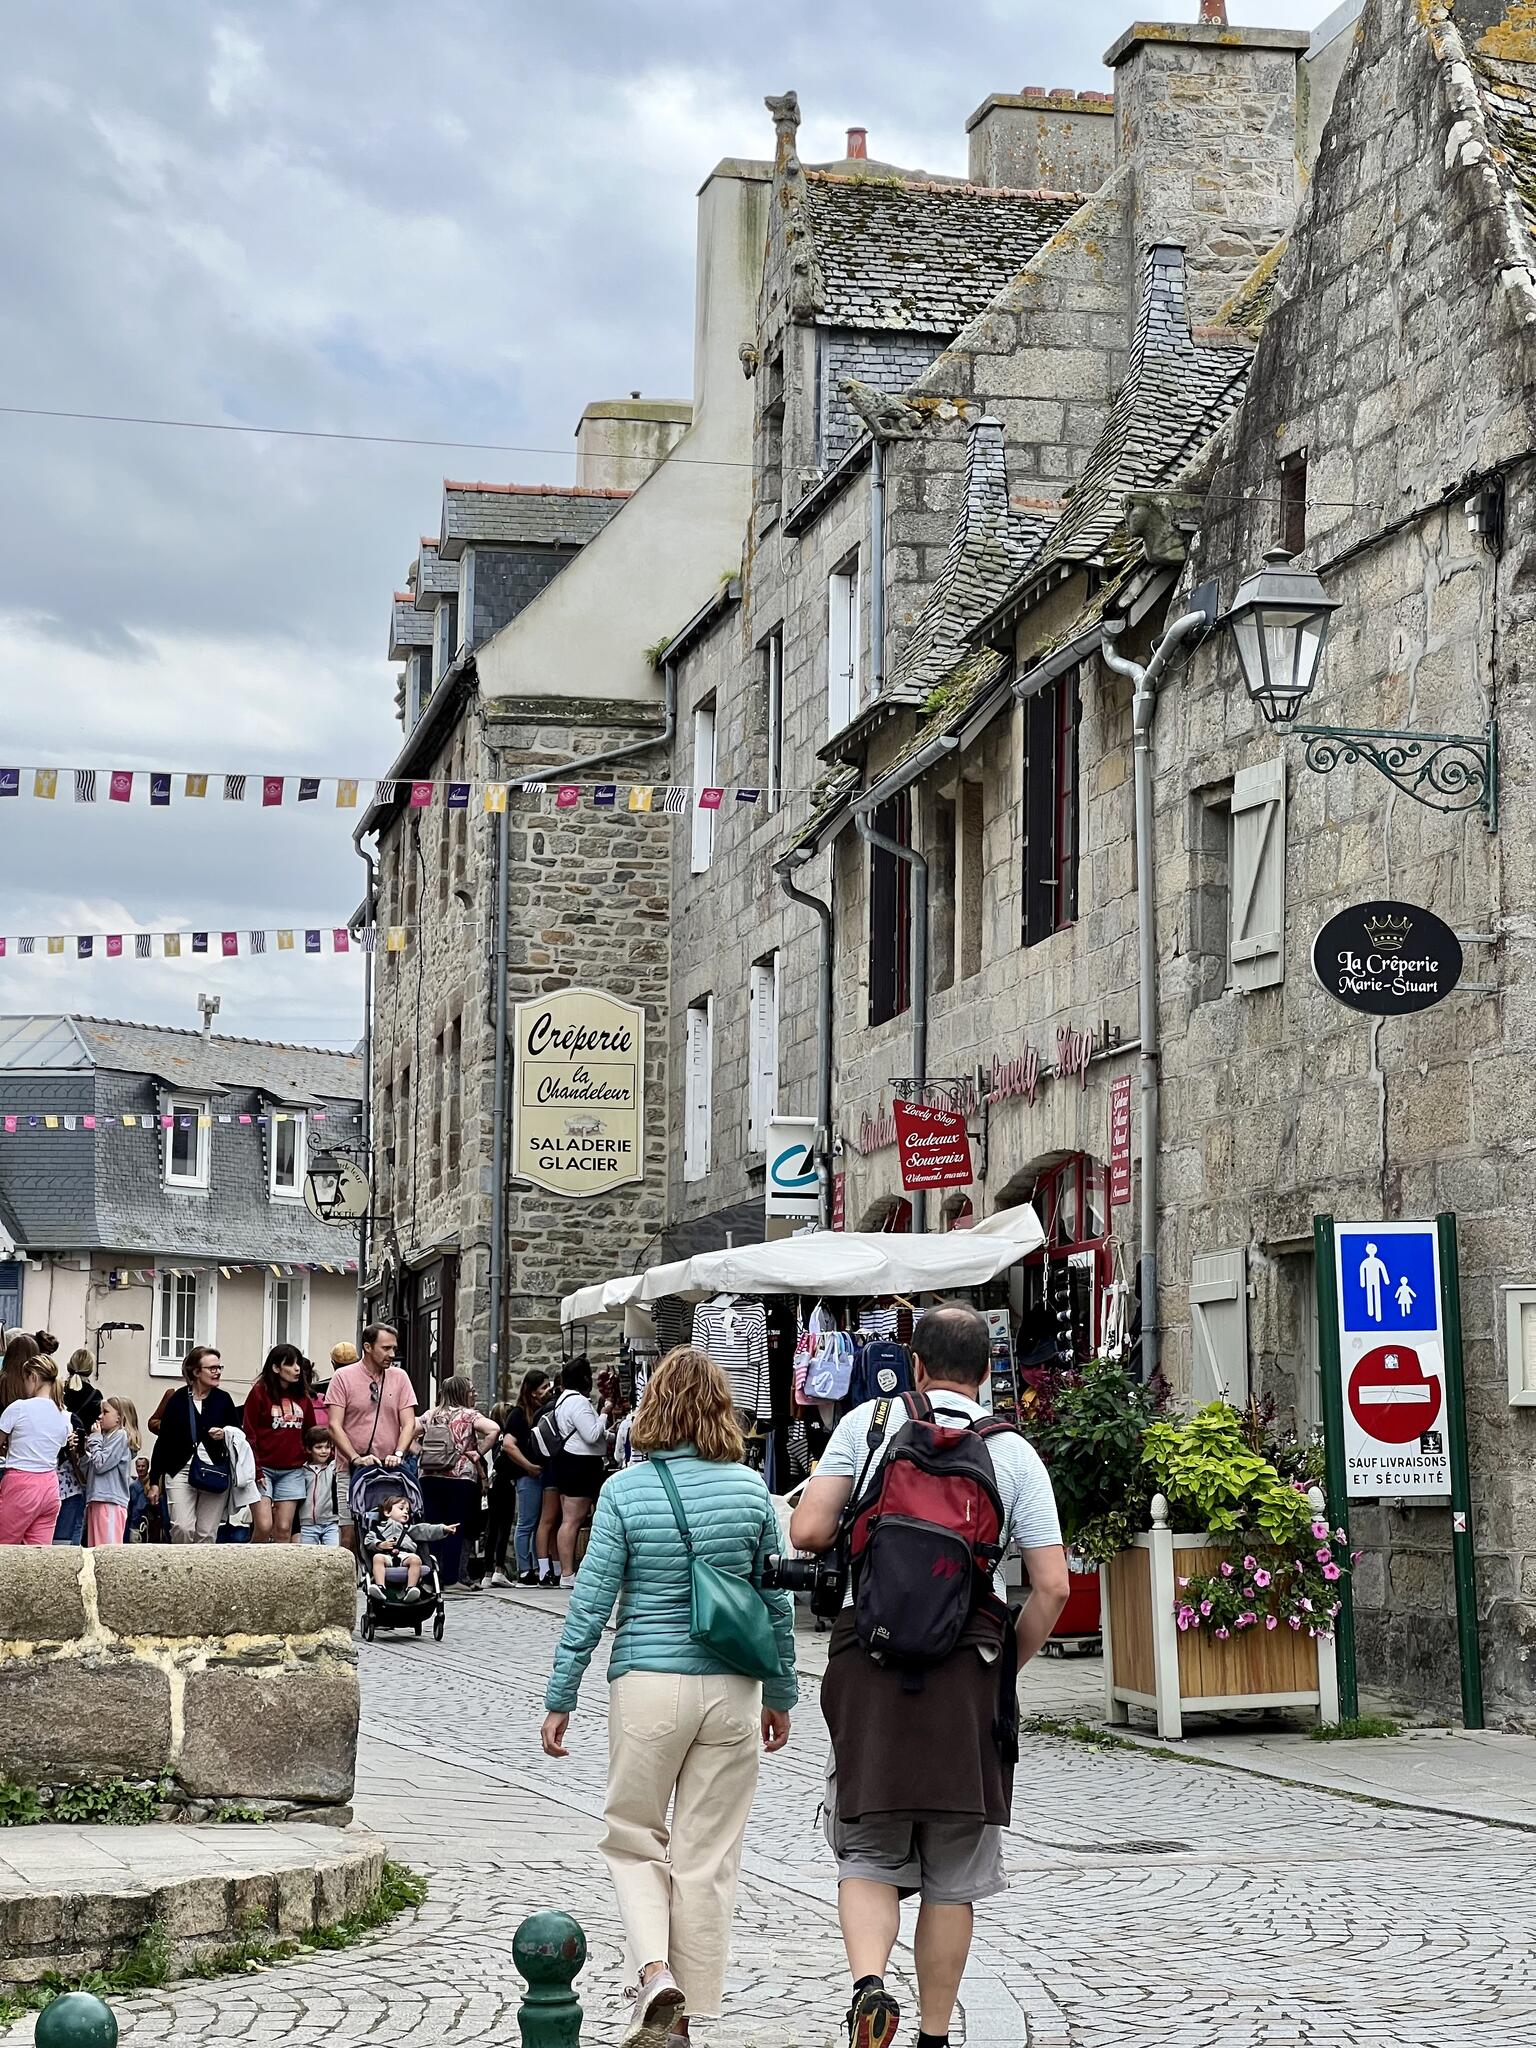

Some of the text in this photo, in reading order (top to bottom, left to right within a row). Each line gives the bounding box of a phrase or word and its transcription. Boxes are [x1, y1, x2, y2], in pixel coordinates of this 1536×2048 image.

[1338, 952, 1439, 978] La Crêperie
[1339, 977, 1438, 996] Marie-Stuart
[528, 1012, 633, 1060] Crêperie
[573, 1065, 591, 1083] la
[537, 1076, 631, 1103] Chandeleur
[902, 1104, 957, 1126] Lovely Shop
[530, 1138, 631, 1152] SALADERIE
[905, 1132, 960, 1148] Cadeaux
[539, 1157, 618, 1171] GLACIER
[906, 1152, 964, 1168] Souvenirs
[905, 1170, 969, 1183] Vêtements marins
[874, 1401, 888, 1425] Nikon
[1348, 1456, 1447, 1468] SAUF LIVRAISONS
[1353, 1471, 1444, 1485] ET SÉCURITÉ
